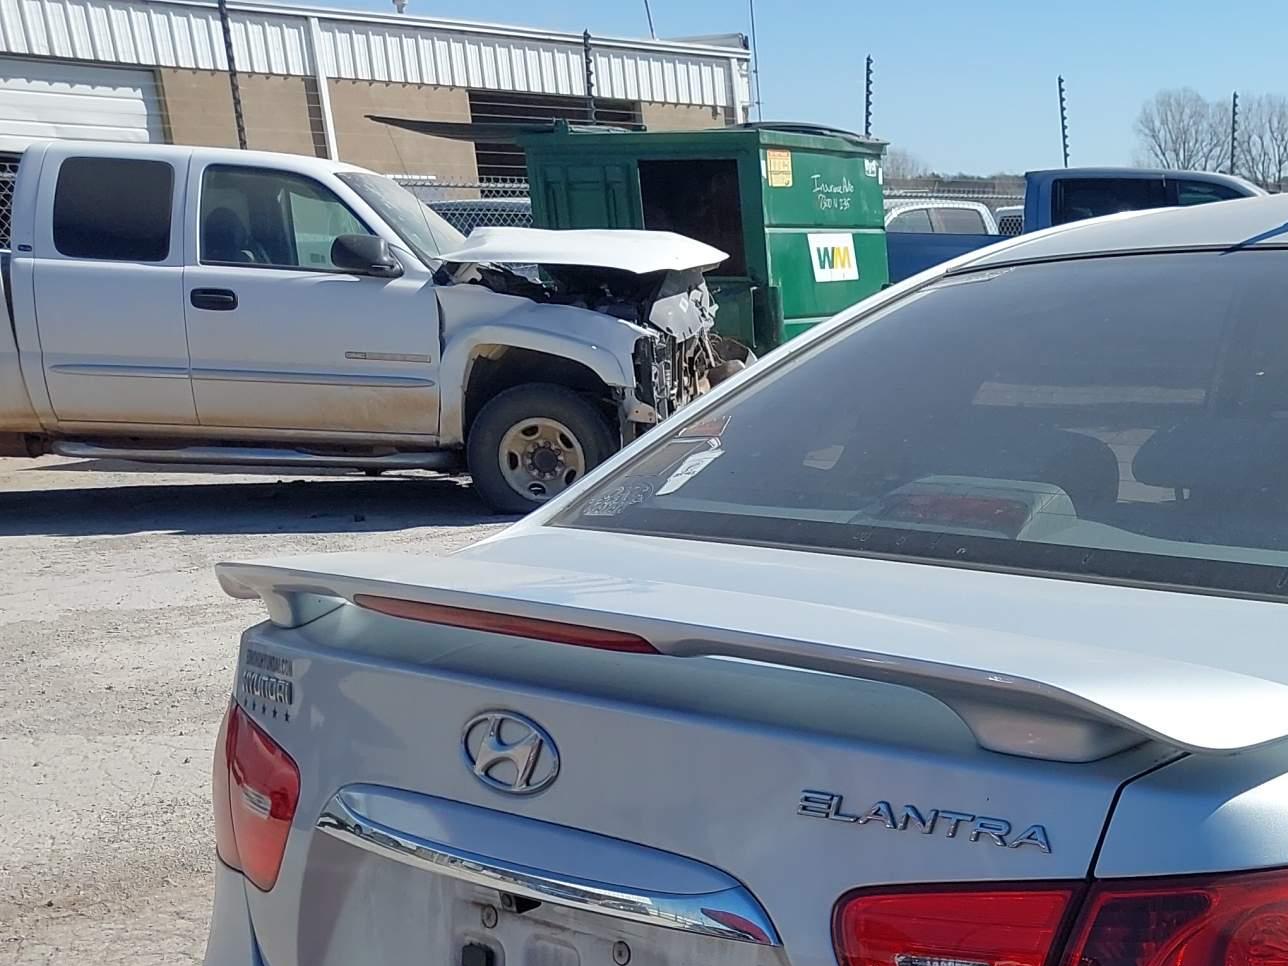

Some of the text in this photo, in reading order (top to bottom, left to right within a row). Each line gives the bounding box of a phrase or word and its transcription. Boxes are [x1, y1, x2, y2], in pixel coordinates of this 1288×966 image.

[816, 246, 851, 270] WM
[242, 672, 293, 705] HYUNDAI
[797, 788, 1052, 854] ELANTRA
